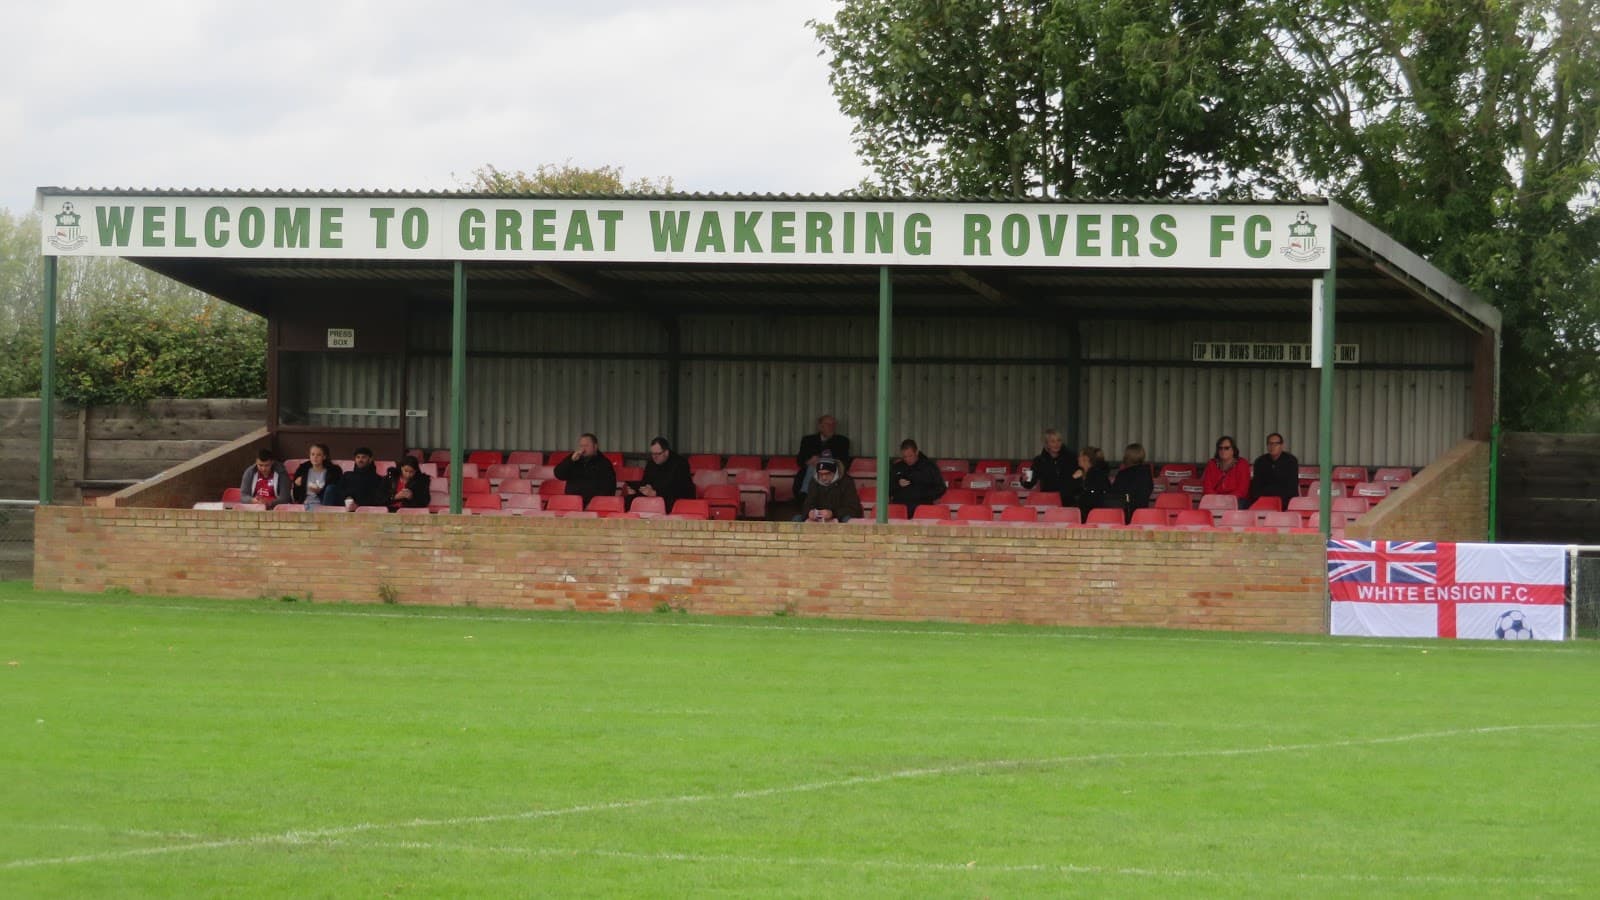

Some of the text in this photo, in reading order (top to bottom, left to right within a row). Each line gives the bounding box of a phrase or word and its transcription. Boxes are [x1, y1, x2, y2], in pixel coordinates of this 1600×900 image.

[97, 207, 1272, 259] WELCOME TO GREAT WAKERING ROVERS FC
[1194, 343, 1207, 360] TOP
[1211, 343, 1226, 360] TWO
[1229, 343, 1250, 361] ROWS
[1253, 343, 1284, 361] RESERVED
[1289, 344, 1302, 361] FOR
[1340, 345, 1356, 361] ONLY
[1357, 585, 1534, 602] WHITE ENSIGN F.C.
